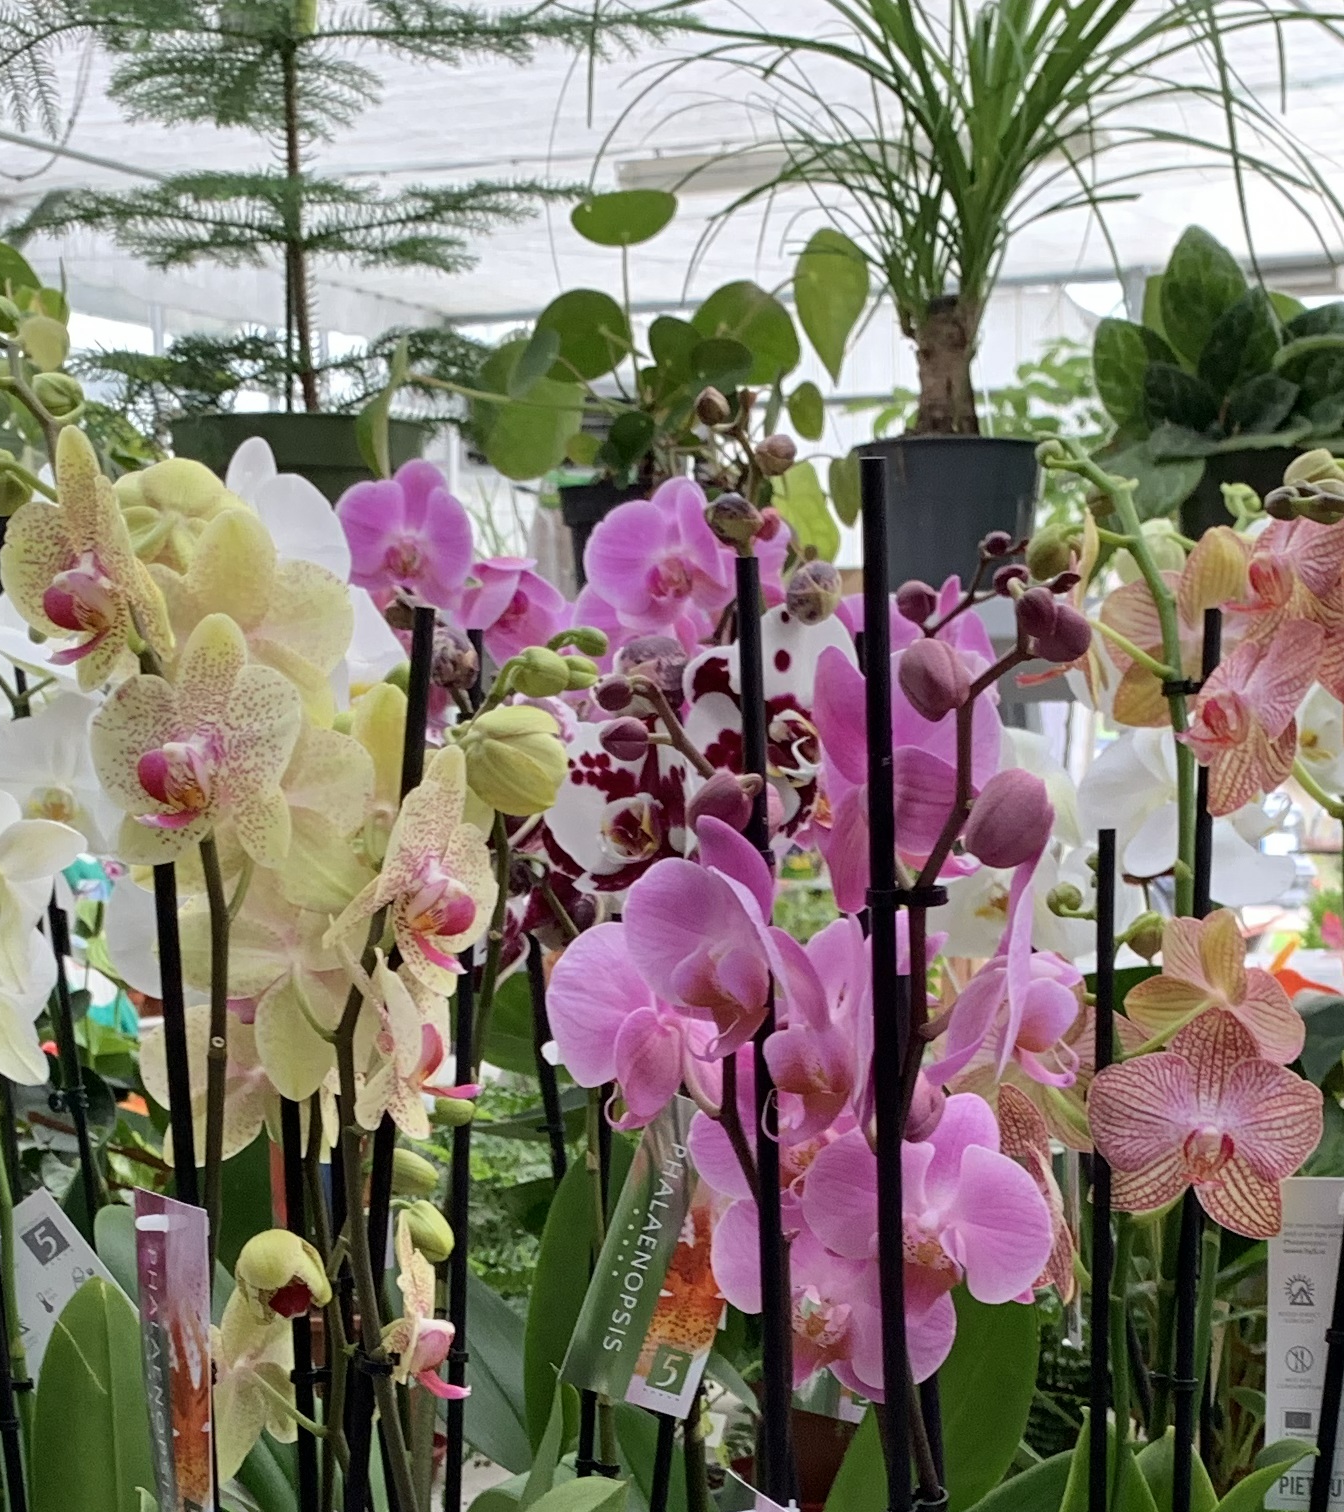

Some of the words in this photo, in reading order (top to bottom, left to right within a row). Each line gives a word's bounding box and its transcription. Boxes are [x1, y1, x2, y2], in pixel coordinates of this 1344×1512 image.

[33, 1225, 58, 1260] 5
[602, 1141, 688, 1353] PHALAENOPSIS
[654, 1354, 684, 1389] 5
